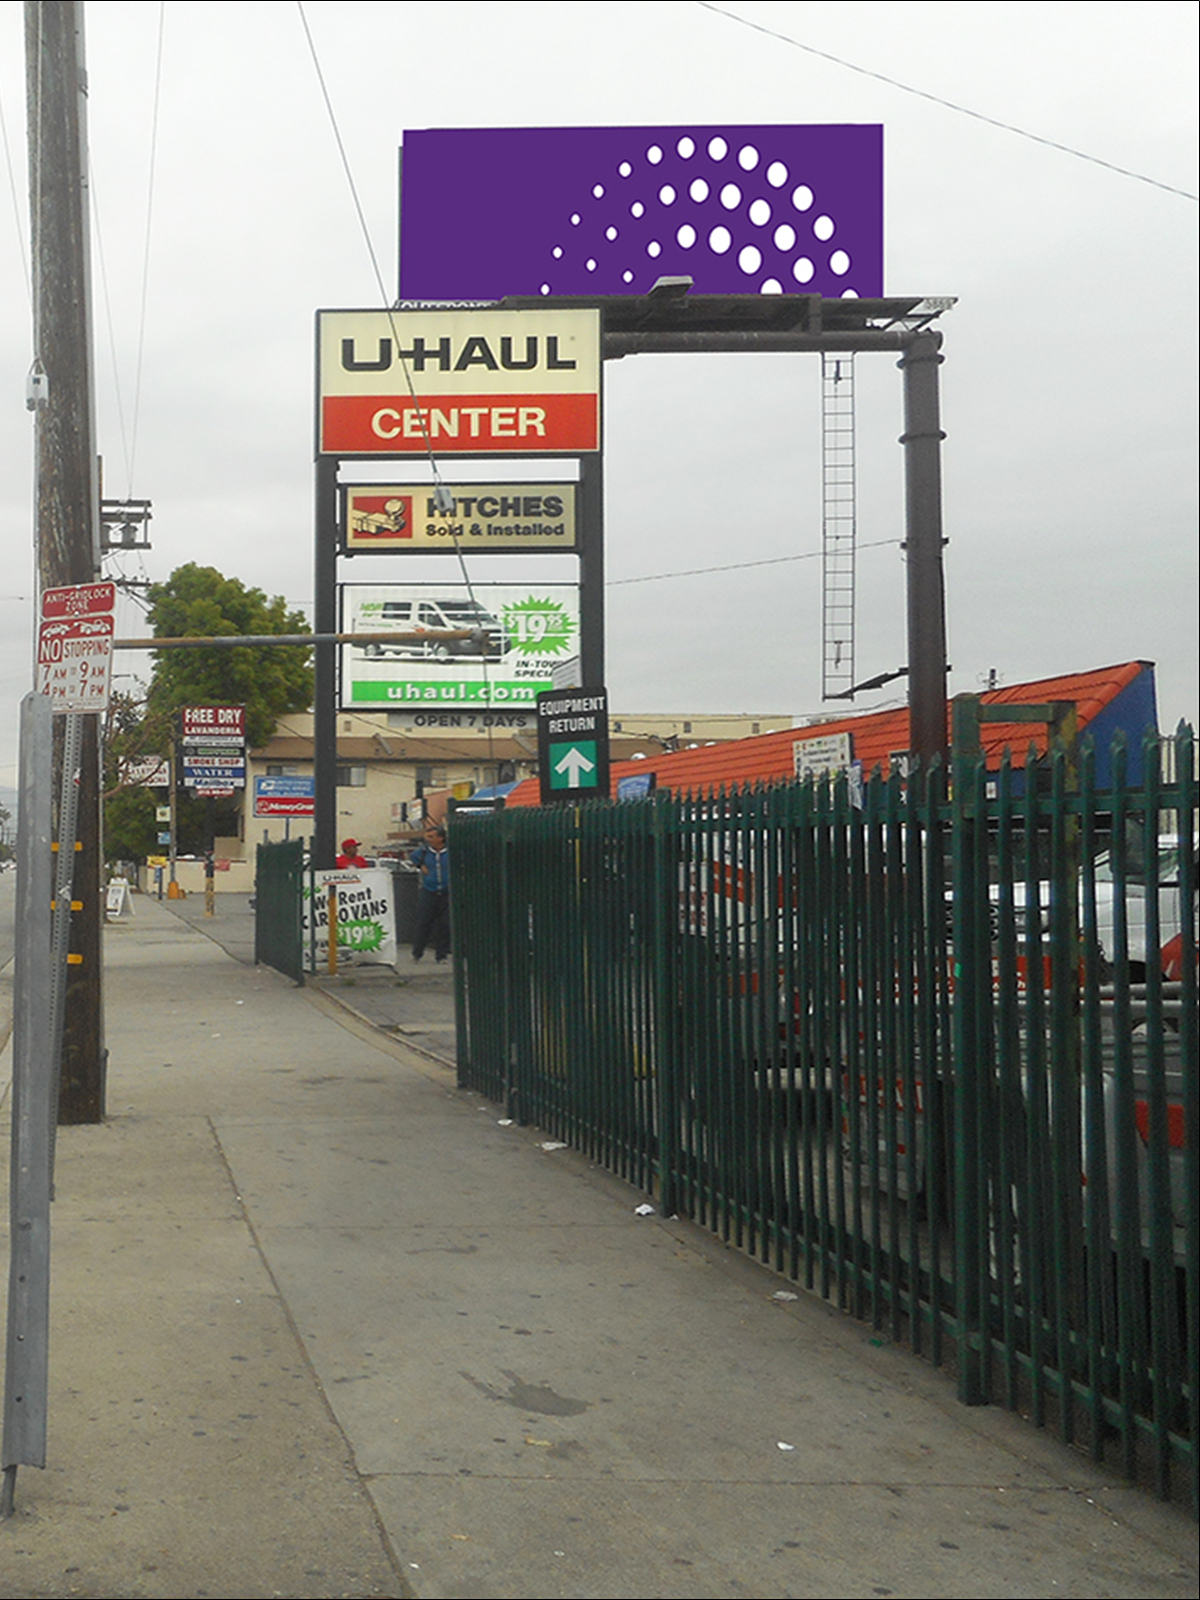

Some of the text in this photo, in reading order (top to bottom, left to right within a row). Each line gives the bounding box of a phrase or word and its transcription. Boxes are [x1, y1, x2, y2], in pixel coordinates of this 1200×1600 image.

[371, 406, 546, 439] CENTER
[426, 496, 564, 518] HITCHES
[425, 523, 565, 536] Sold & Installed
[45, 587, 112, 604] ANTI-GRIDLOCK
[65, 599, 90, 612] ZONE
[40, 638, 109, 662] NO STOPPING
[43, 664, 51, 681] 7
[53, 668, 68, 680] AM
[79, 660, 89, 679] 9
[91, 667, 106, 678] AM
[42, 682, 51, 696] 4
[52, 686, 67, 699] PM
[79, 679, 89, 697] 7
[90, 684, 105, 696] PM
[387, 683, 535, 700] uhaul.com
[539, 696, 605, 716] EQUIPMENT
[185, 709, 242, 724] FREE DRY
[414, 714, 527, 727] OPEN 7 DAYS
[185, 726, 242, 735] LAVANDERIA
[548, 717, 595, 734] RETURN
[188, 758, 240, 766] SMOKE SHOP
[192, 768, 233, 777] WATER
[338, 887, 373, 906] Rent
[350, 899, 388, 920] VANS
